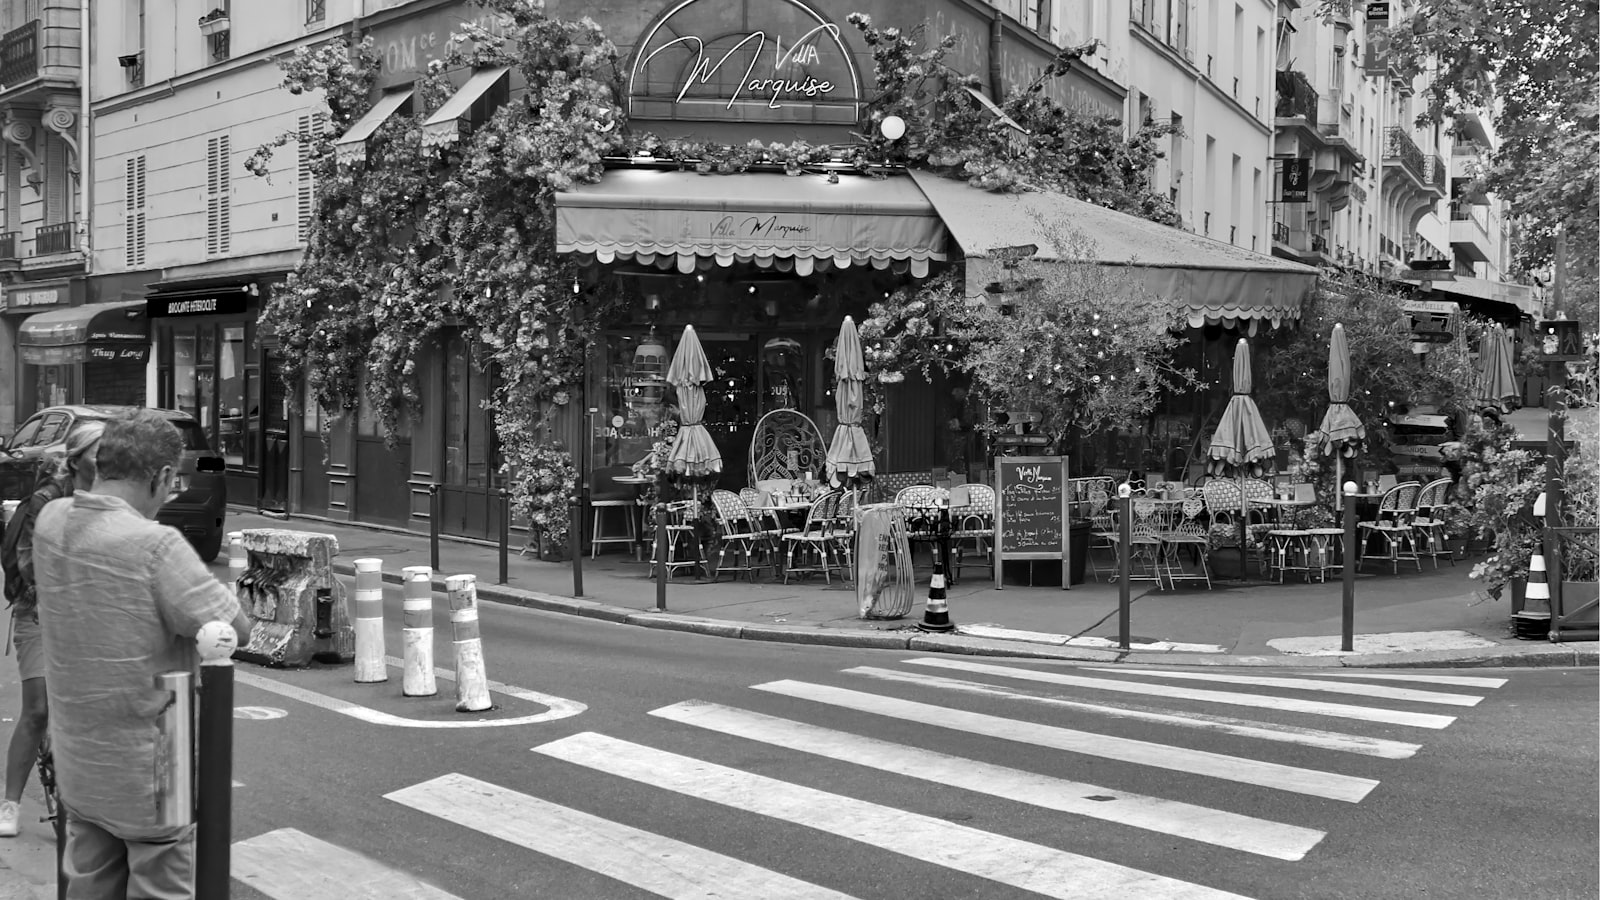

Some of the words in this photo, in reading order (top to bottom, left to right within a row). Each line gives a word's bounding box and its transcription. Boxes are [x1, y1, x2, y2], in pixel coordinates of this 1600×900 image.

[640, 31, 835, 110] Marquise
[740, 215, 811, 239] Marquise
[91, 347, 116, 360] Thuy
[120, 348, 144, 360] Long
